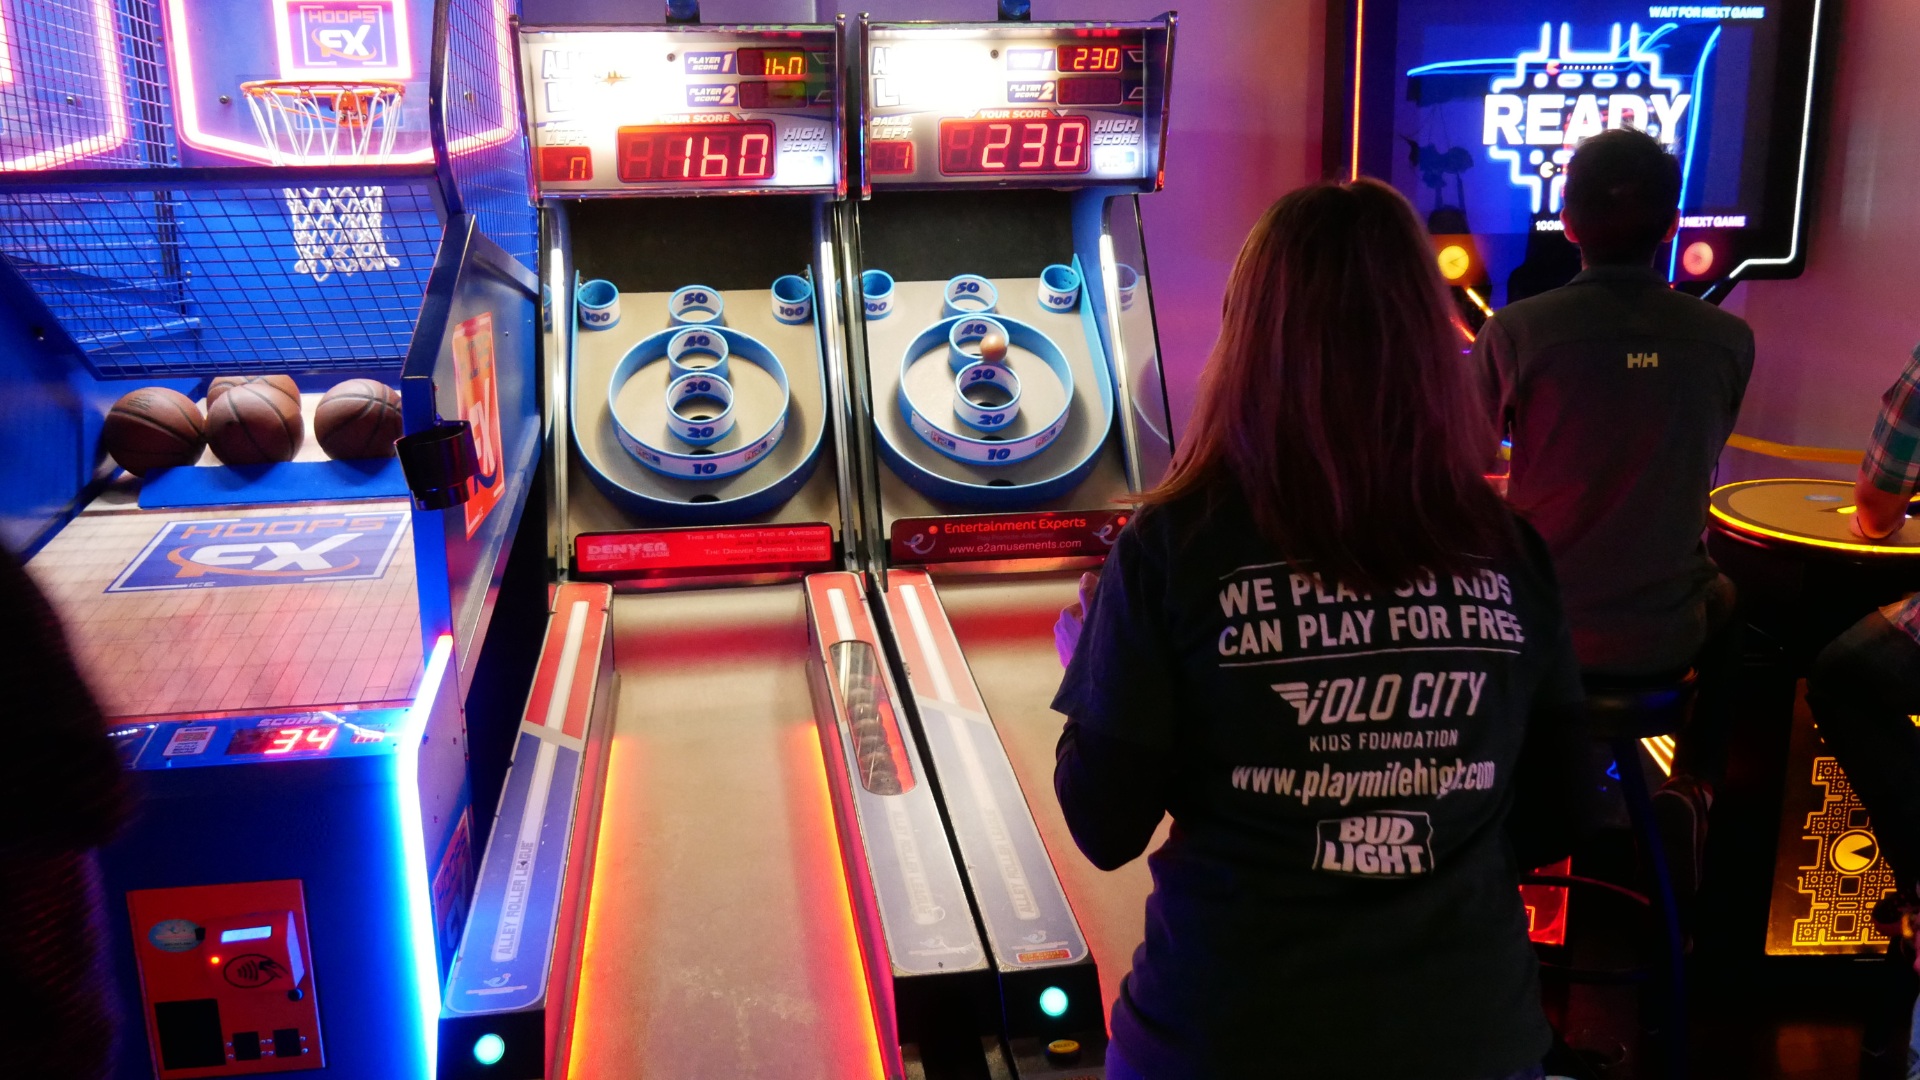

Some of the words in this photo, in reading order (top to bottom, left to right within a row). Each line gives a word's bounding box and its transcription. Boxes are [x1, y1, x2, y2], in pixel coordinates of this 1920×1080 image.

[309, 10, 376, 23] HOOPS
[1649, 7, 1679, 18] WAIT
[1678, 7, 1701, 18] FOR
[1702, 7, 1731, 18] NEXT
[1731, 7, 1765, 18] GAME
[722, 53, 734, 73] 1
[1073, 48, 1119, 69] 230
[719, 85, 736, 104] 2
[1010, 84, 1041, 92] PLAYER
[1038, 82, 1055, 101] 2
[659, 114, 691, 123] YOUR
[692, 114, 730, 122] SCORE
[980, 110, 1010, 118] YOUR
[1012, 110, 1047, 118] SCORE
[1483, 94, 1692, 145] READY
[872, 117, 912, 126] BALLS
[1094, 120, 1139, 133] HIGH
[783, 127, 827, 140] HIGH
[872, 127, 912, 139] LEFT
[1093, 134, 1140, 145] SCORE
[782, 141, 828, 152] SCORE
[982, 123, 1084, 168] 230
[904, 145, 911, 169] 1
[1684, 216, 1714, 227] NEXT
[1714, 216, 1746, 227] GAME
[955, 282, 979, 294] 50
[683, 293, 708, 306] 50
[1048, 295, 1073, 305] 100
[584, 311, 610, 323] 100
[779, 305, 804, 317] 100
[961, 324, 987, 335] 40
[684, 336, 710, 347] 40
[1627, 353, 1658, 368] HH
[970, 369, 996, 380] 30
[685, 381, 711, 393] 30
[978, 413, 1005, 425] 20
[687, 426, 714, 438] 20
[987, 449, 1010, 460] 10
[692, 463, 717, 475] 10
[180, 517, 387, 539] HOOPS
[944, 519, 1036, 534] Entertainment
[1039, 518, 1086, 531] Experts
[587, 542, 668, 554] DENVER
[949, 539, 1082, 554] www.e2amusements.com
[1219, 578, 1277, 618] WE
[1289, 571, 1373, 606] PLA
[1452, 567, 1512, 605] KIDS
[1218, 618, 1283, 656] CAN
[1297, 609, 1376, 649] PLAY
[1387, 605, 1452, 643] FOR
[1459, 604, 1525, 644] FREE
[1272, 674, 1402, 726] VOLO
[1408, 671, 1487, 719] CITY
[257, 716, 323, 727] SCORE
[264, 728, 337, 754] 34
[1309, 734, 1351, 752] KIDS
[1358, 729, 1459, 750] FOUNDATION
[1338, 817, 1415, 844] BUD
[515, 840, 534, 877] LEAGUE
[1322, 841, 1425, 873] LIGHT
[506, 878, 526, 917] ROLLER
[498, 921, 518, 955] ALLEY
